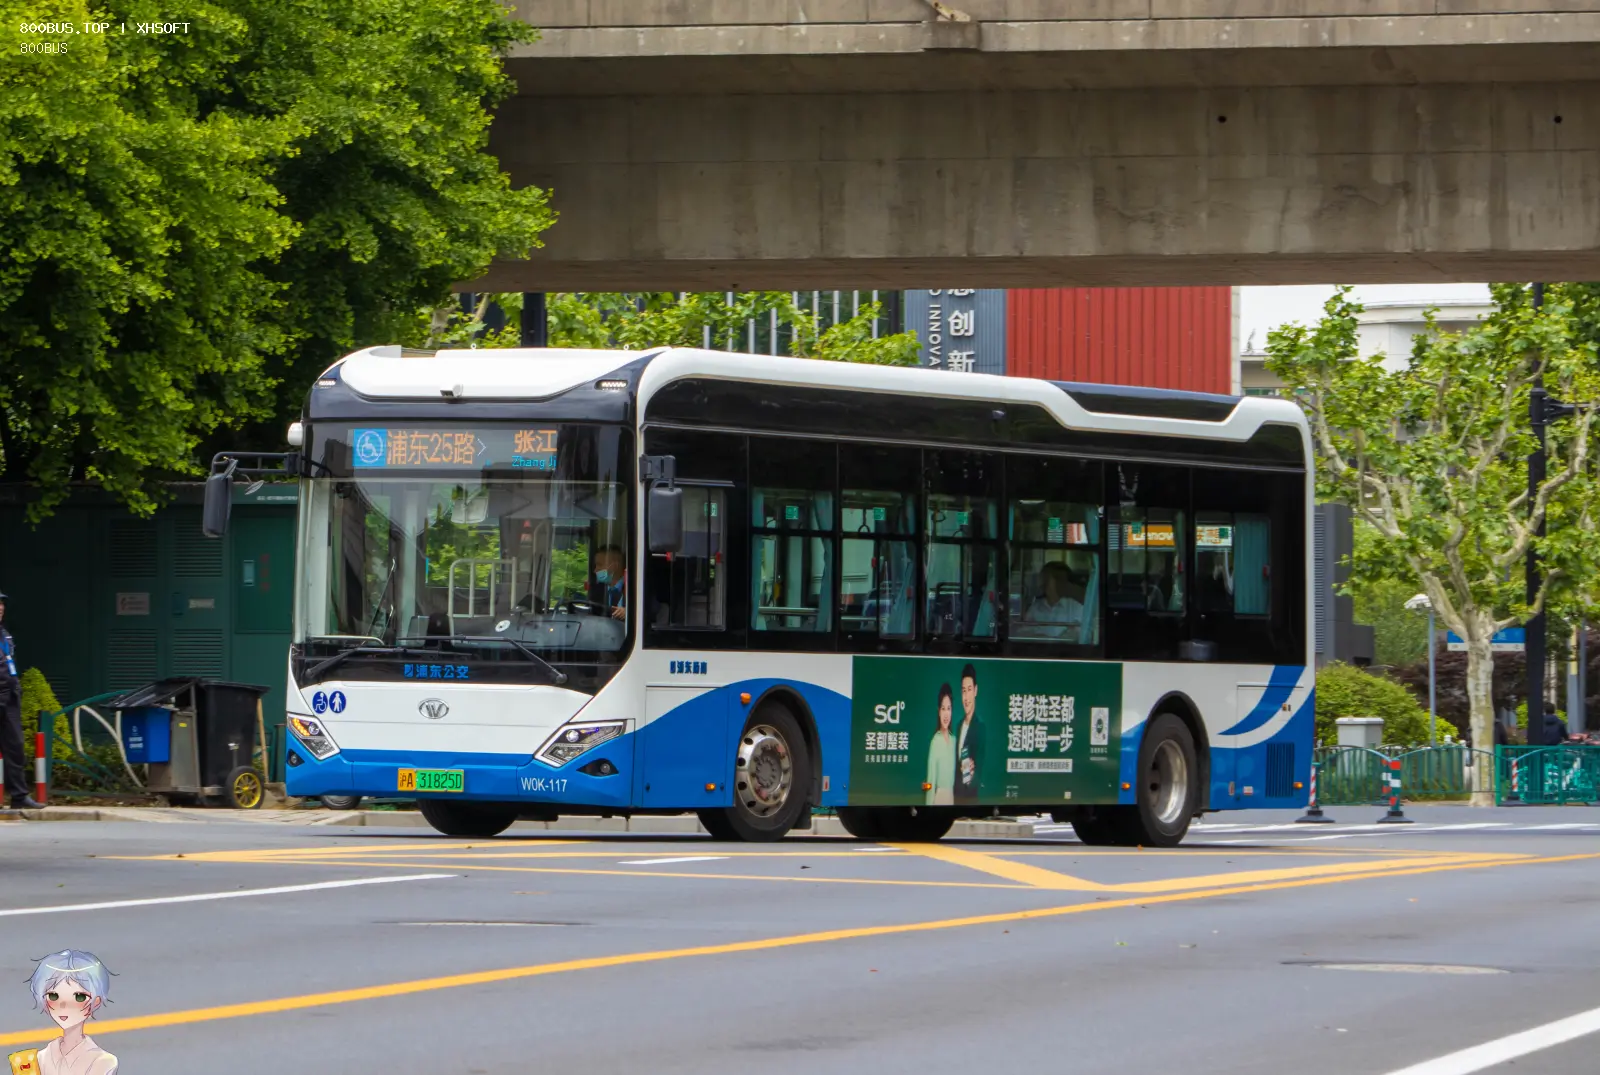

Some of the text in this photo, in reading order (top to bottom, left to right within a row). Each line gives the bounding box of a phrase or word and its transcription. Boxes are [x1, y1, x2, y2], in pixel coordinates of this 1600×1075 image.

[928, 304, 942, 370] INNOVA
[387, 429, 557, 465] 浦东25路 张江
[512, 455, 545, 469] Zhang
[416, 664, 469, 679] 浦东公交
[1008, 693, 1075, 723] 装修选圣都
[865, 732, 909, 750] 圣都整装
[1007, 724, 1074, 753] 透明每一步
